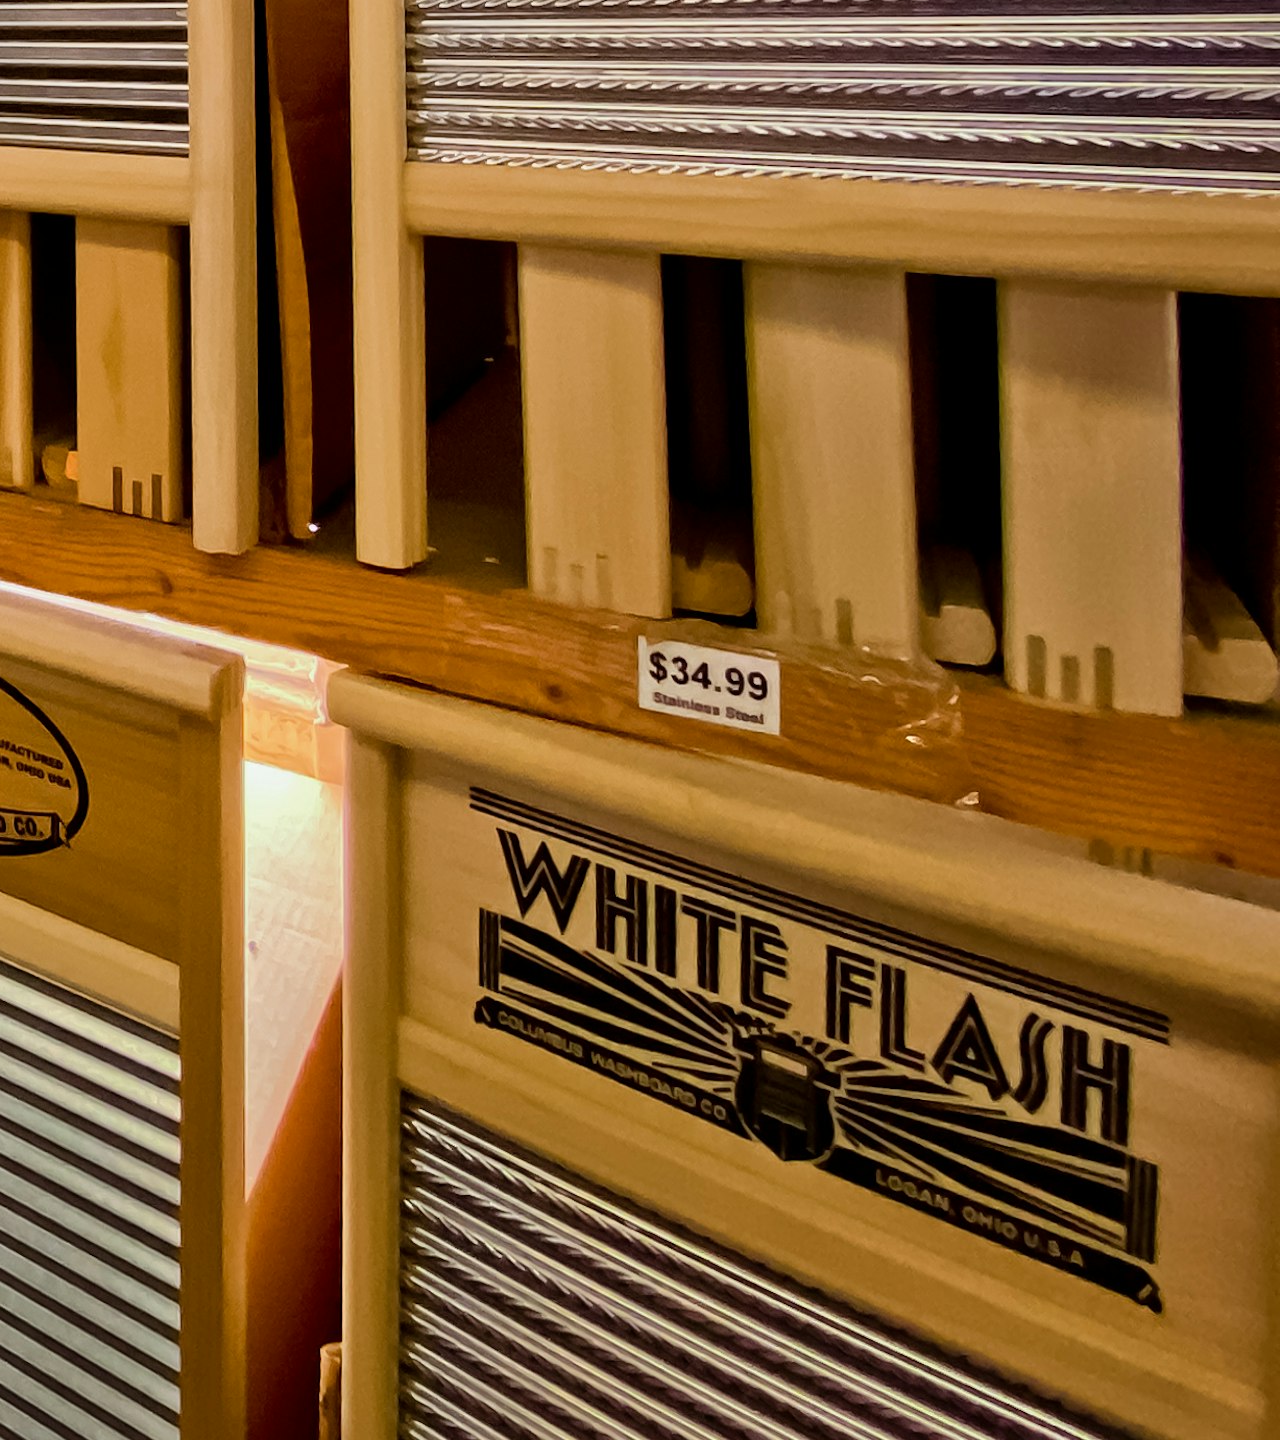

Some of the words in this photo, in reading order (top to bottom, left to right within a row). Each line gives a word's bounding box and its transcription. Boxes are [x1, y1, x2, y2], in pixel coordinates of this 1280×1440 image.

[649, 651, 769, 701] $34.99
[653, 691, 721, 716] Stainless
[725, 707, 765, 725] Steel
[13, 816, 44, 839] CO.
[496, 827, 792, 1020] WHITE
[825, 944, 1132, 1148] FLASH
[497, 1009, 585, 1058] COLUMBUS
[590, 1049, 699, 1108] WASHBOARD
[961, 1205, 1019, 1240] OHIO
